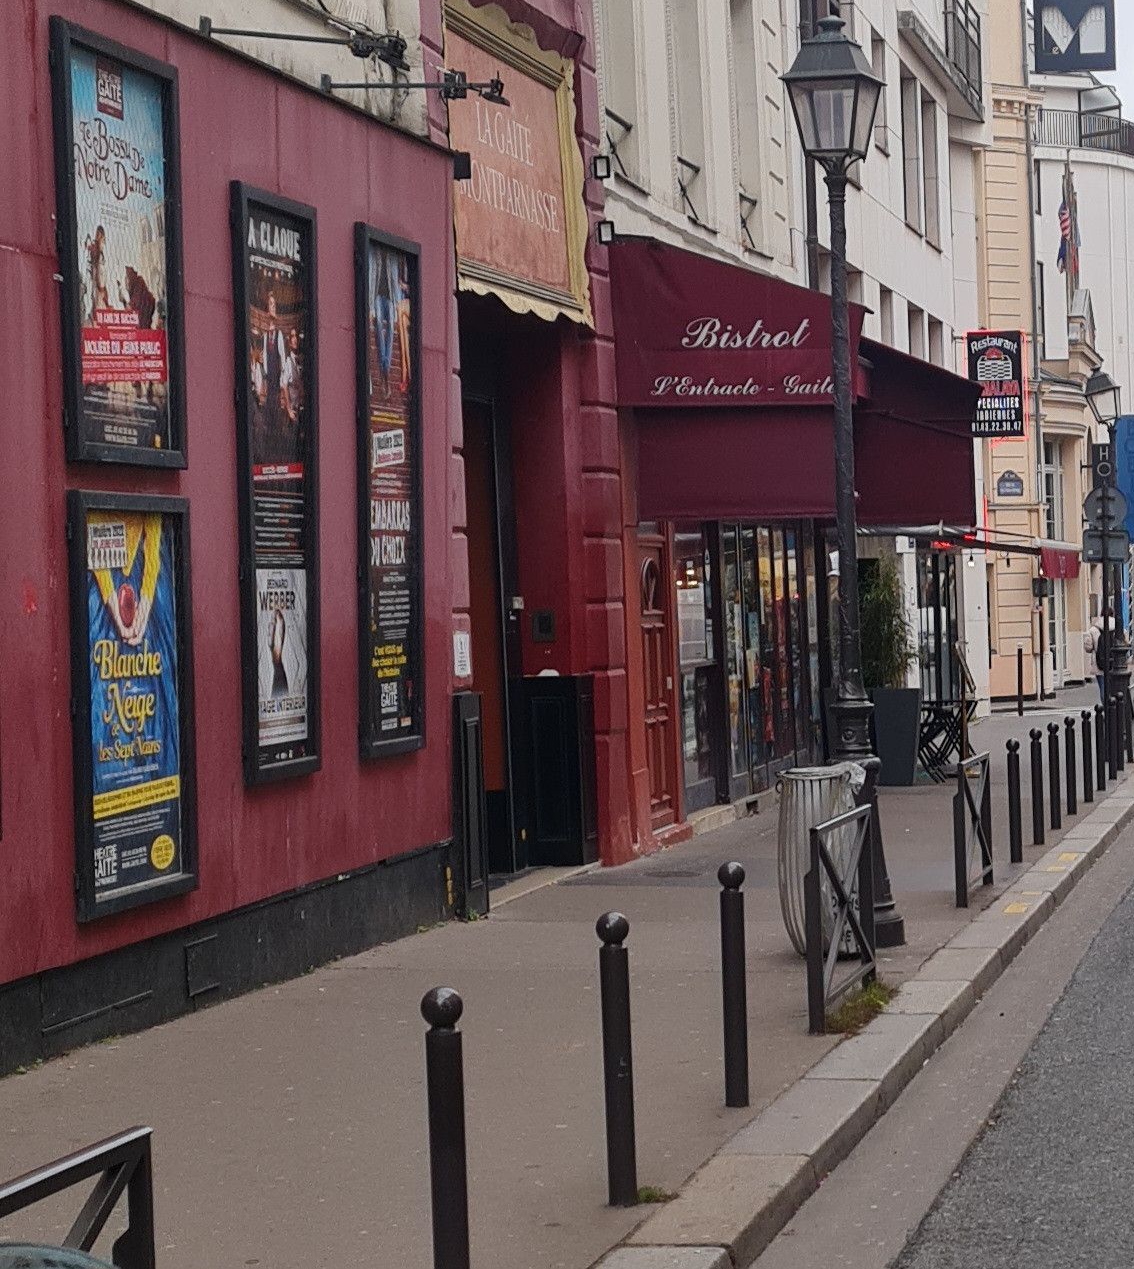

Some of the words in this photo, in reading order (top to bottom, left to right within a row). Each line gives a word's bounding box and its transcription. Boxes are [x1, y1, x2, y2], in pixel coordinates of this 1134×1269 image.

[474, 100, 493, 149] LA
[74, 142, 112, 190] Notre
[111, 160, 153, 201] Dame
[260, 220, 301, 262] CLAQUE
[681, 316, 811, 349] Bistrot
[970, 335, 1018, 354] Restaurant
[650, 375, 762, 396] L'Entracte
[370, 500, 410, 532] EMBARRAS
[259, 590, 296, 612] WERBER
[94, 639, 162, 679] Blanche
[102, 680, 156, 733] Neige
